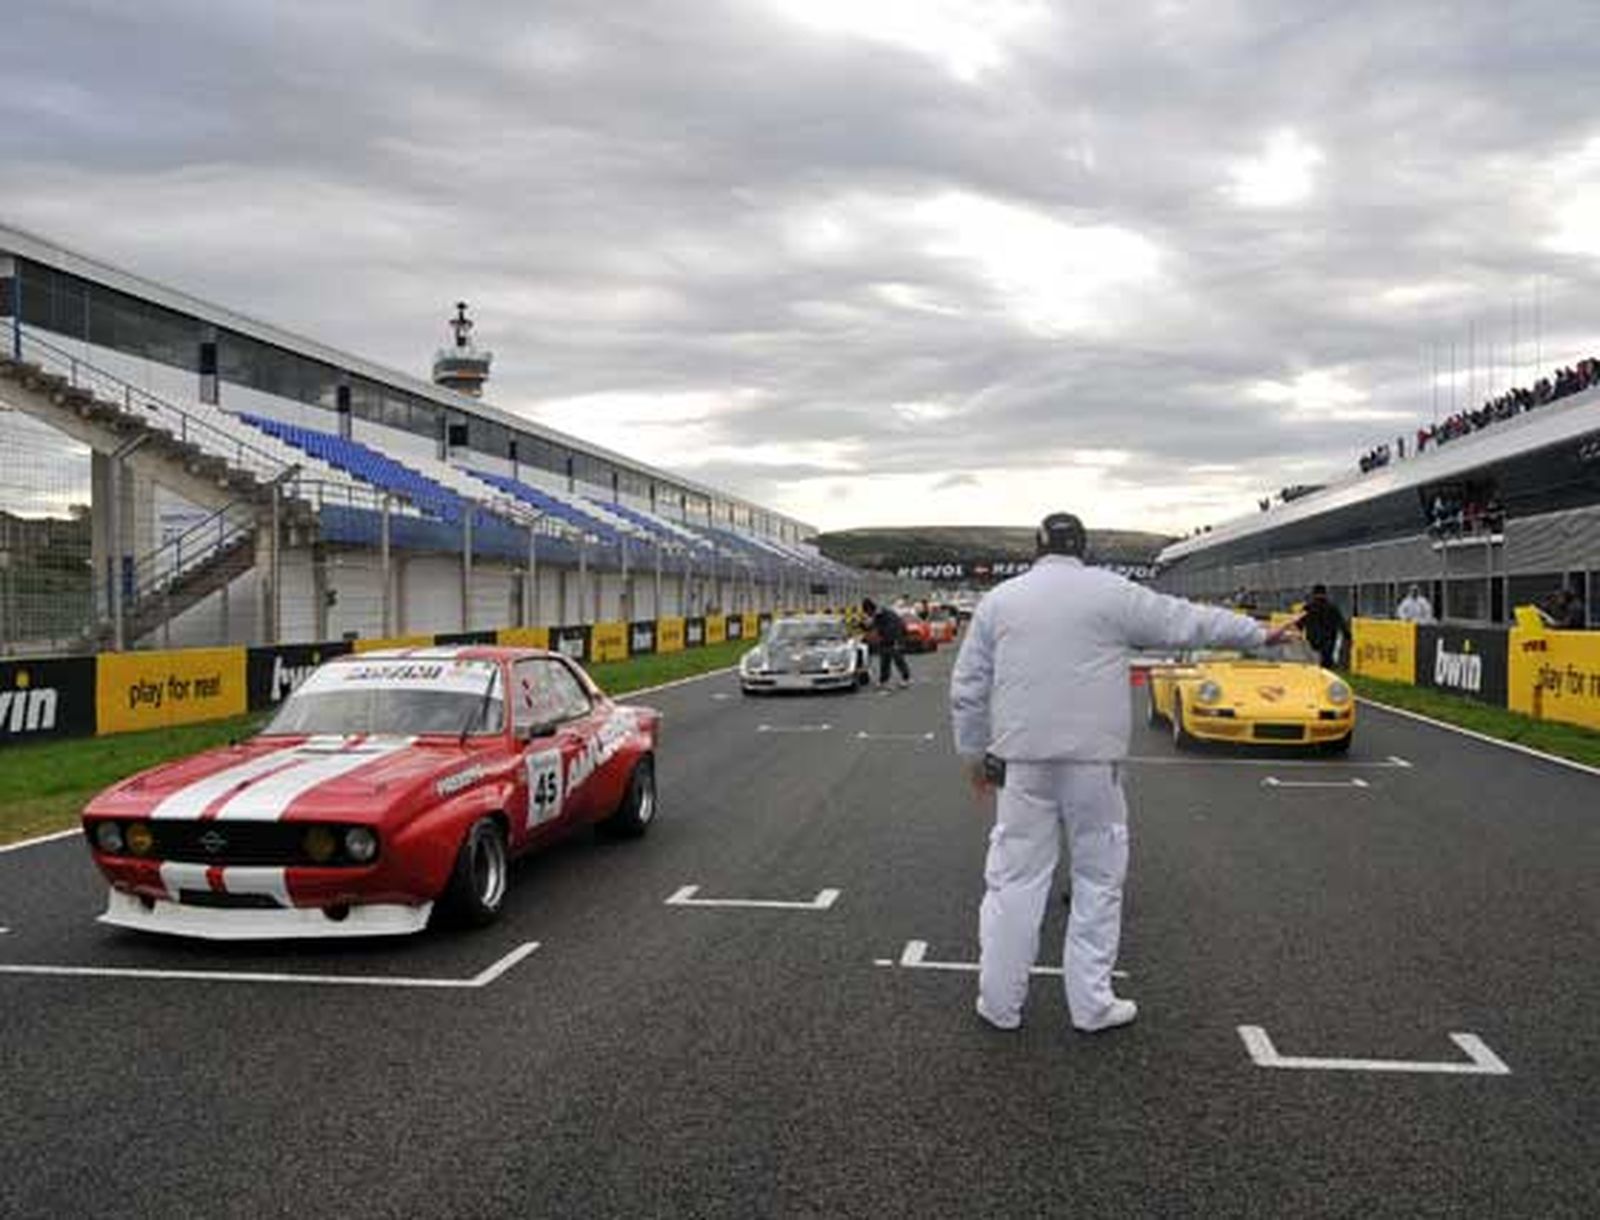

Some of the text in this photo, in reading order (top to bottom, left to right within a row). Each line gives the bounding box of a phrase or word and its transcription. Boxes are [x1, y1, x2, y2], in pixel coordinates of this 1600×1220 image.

[1434, 637, 1482, 690] bwin
[130, 679, 163, 709] play
[168, 674, 191, 701] for
[534, 771, 557, 816] 45
